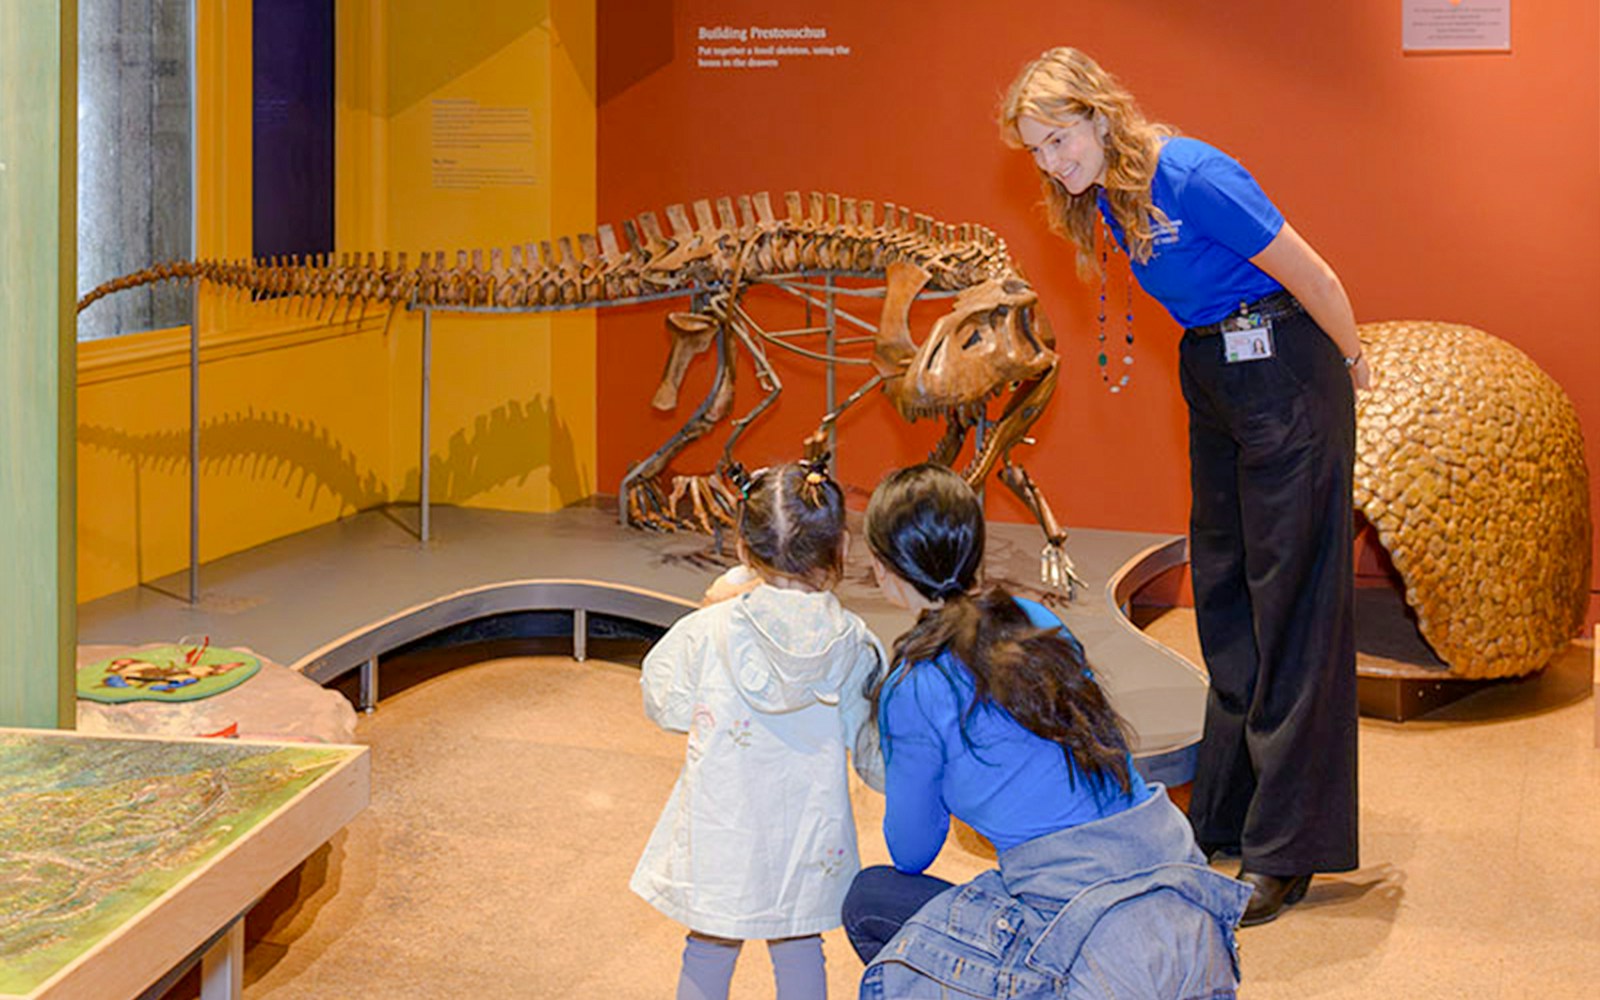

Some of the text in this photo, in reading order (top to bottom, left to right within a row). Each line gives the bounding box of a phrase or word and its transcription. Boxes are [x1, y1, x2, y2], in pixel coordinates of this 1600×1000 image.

[699, 26, 827, 42] Building Prestosuchus
[713, 46, 746, 57] together
[835, 45, 850, 55] the
[722, 58, 731, 67] in
[732, 58, 746, 67] the
